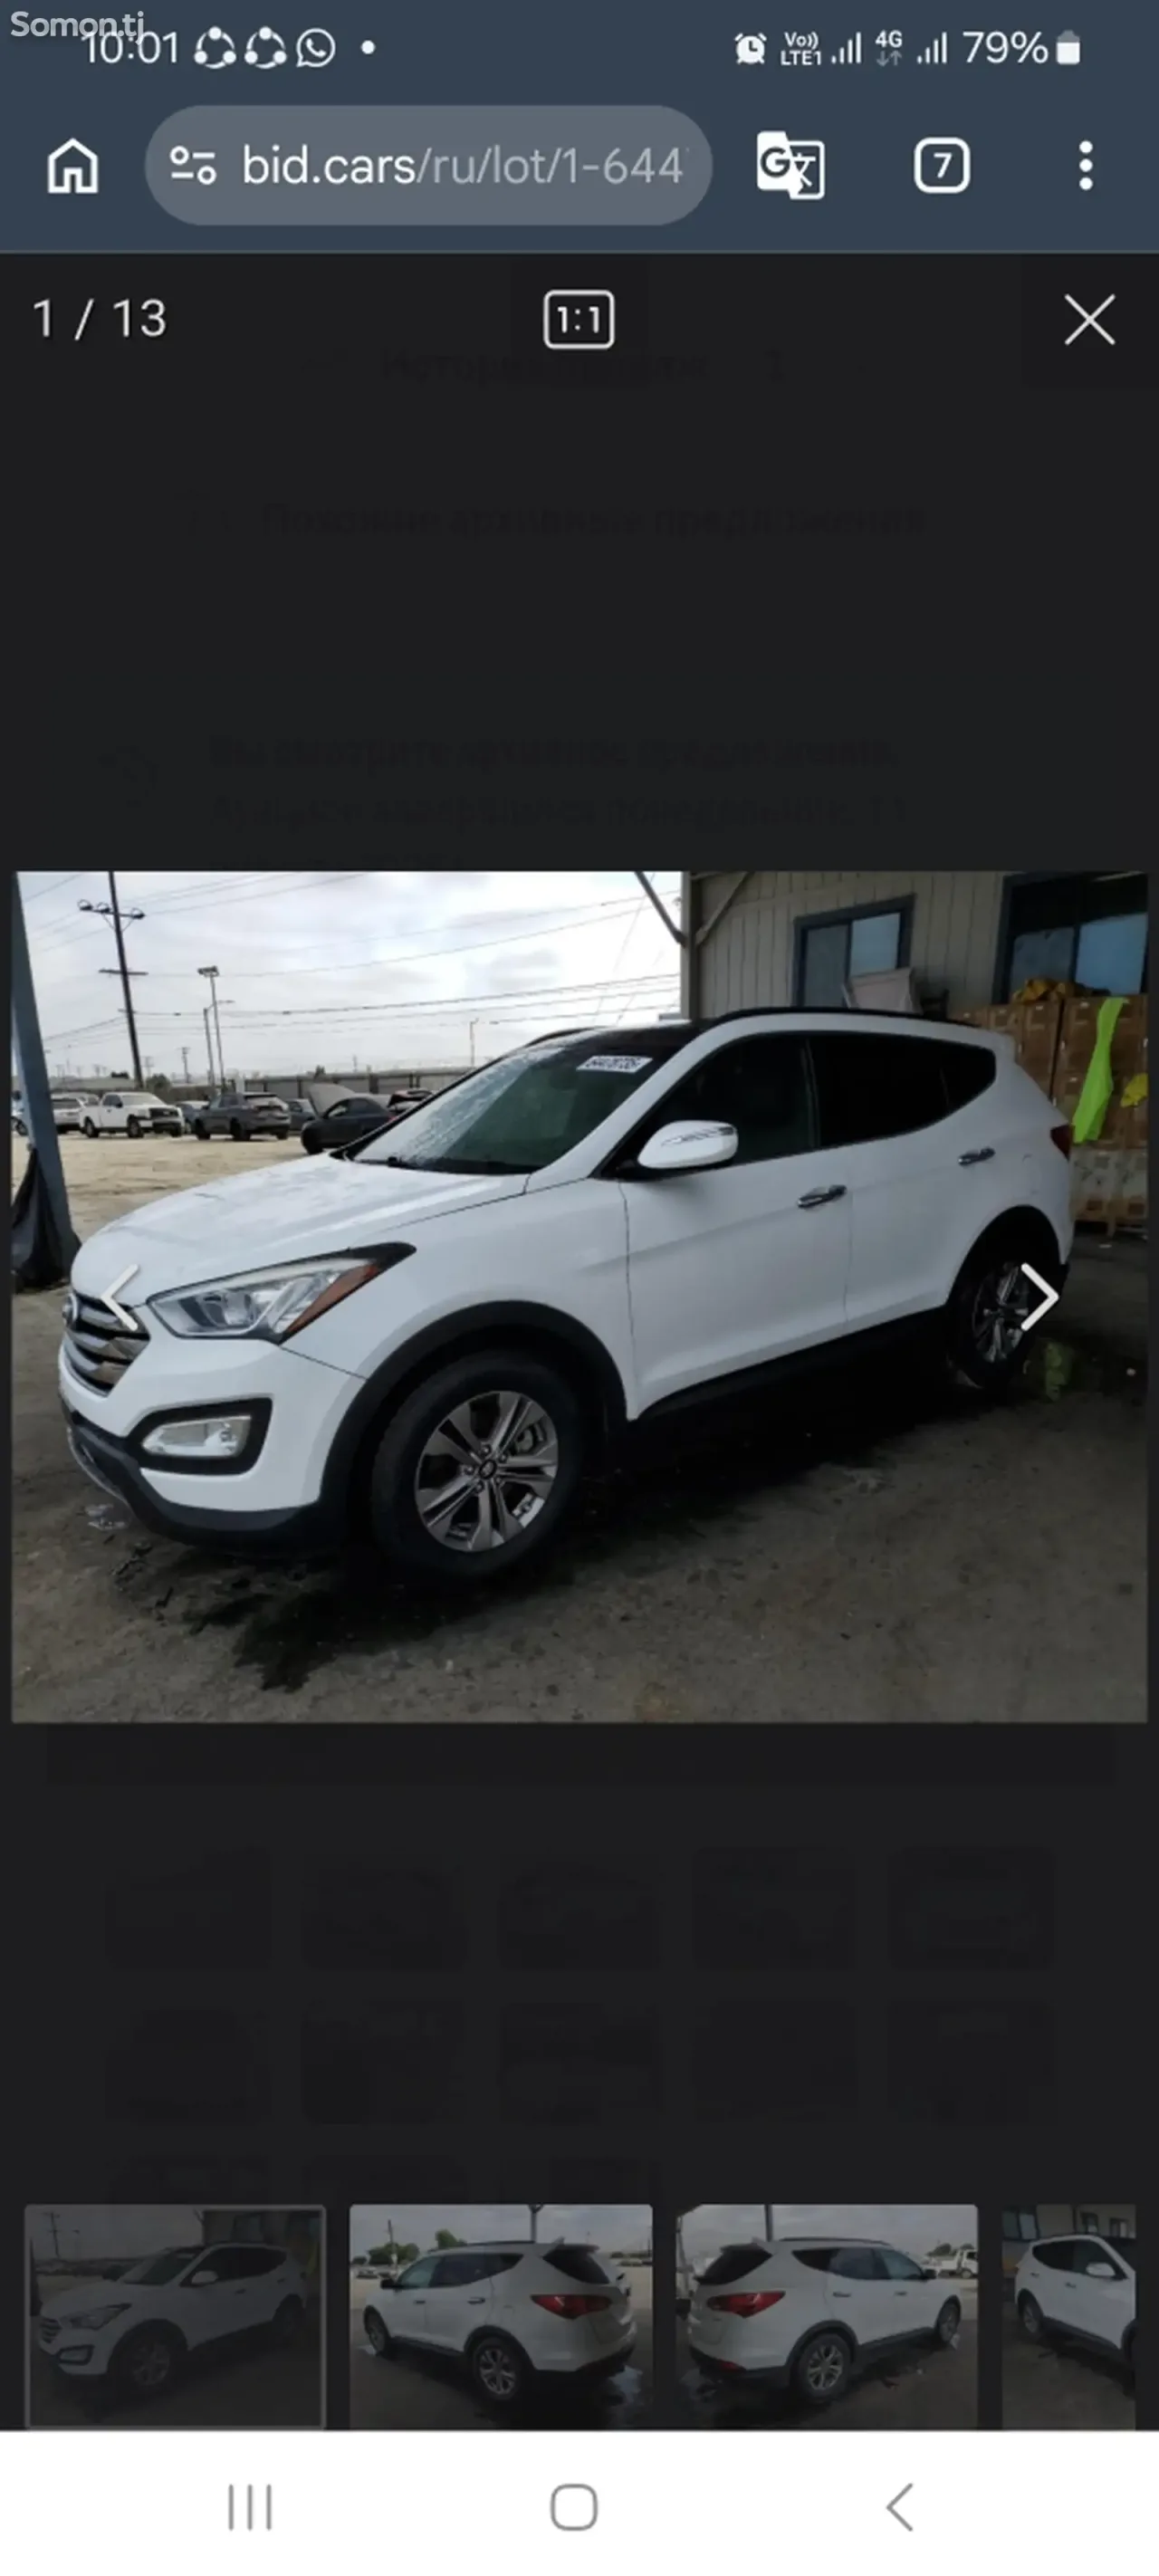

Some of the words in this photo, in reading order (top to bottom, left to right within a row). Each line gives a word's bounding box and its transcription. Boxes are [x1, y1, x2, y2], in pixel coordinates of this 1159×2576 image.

[81, 31, 177, 64] 10:01
[875, 29, 904, 48] 4G
[962, 31, 1049, 64] 79%
[780, 49, 822, 66] LTE1
[934, 153, 953, 178] 7
[32, 299, 52, 339] 1
[73, 298, 95, 341] /
[112, 299, 168, 339] 13
[556, 305, 601, 334] 1:1
